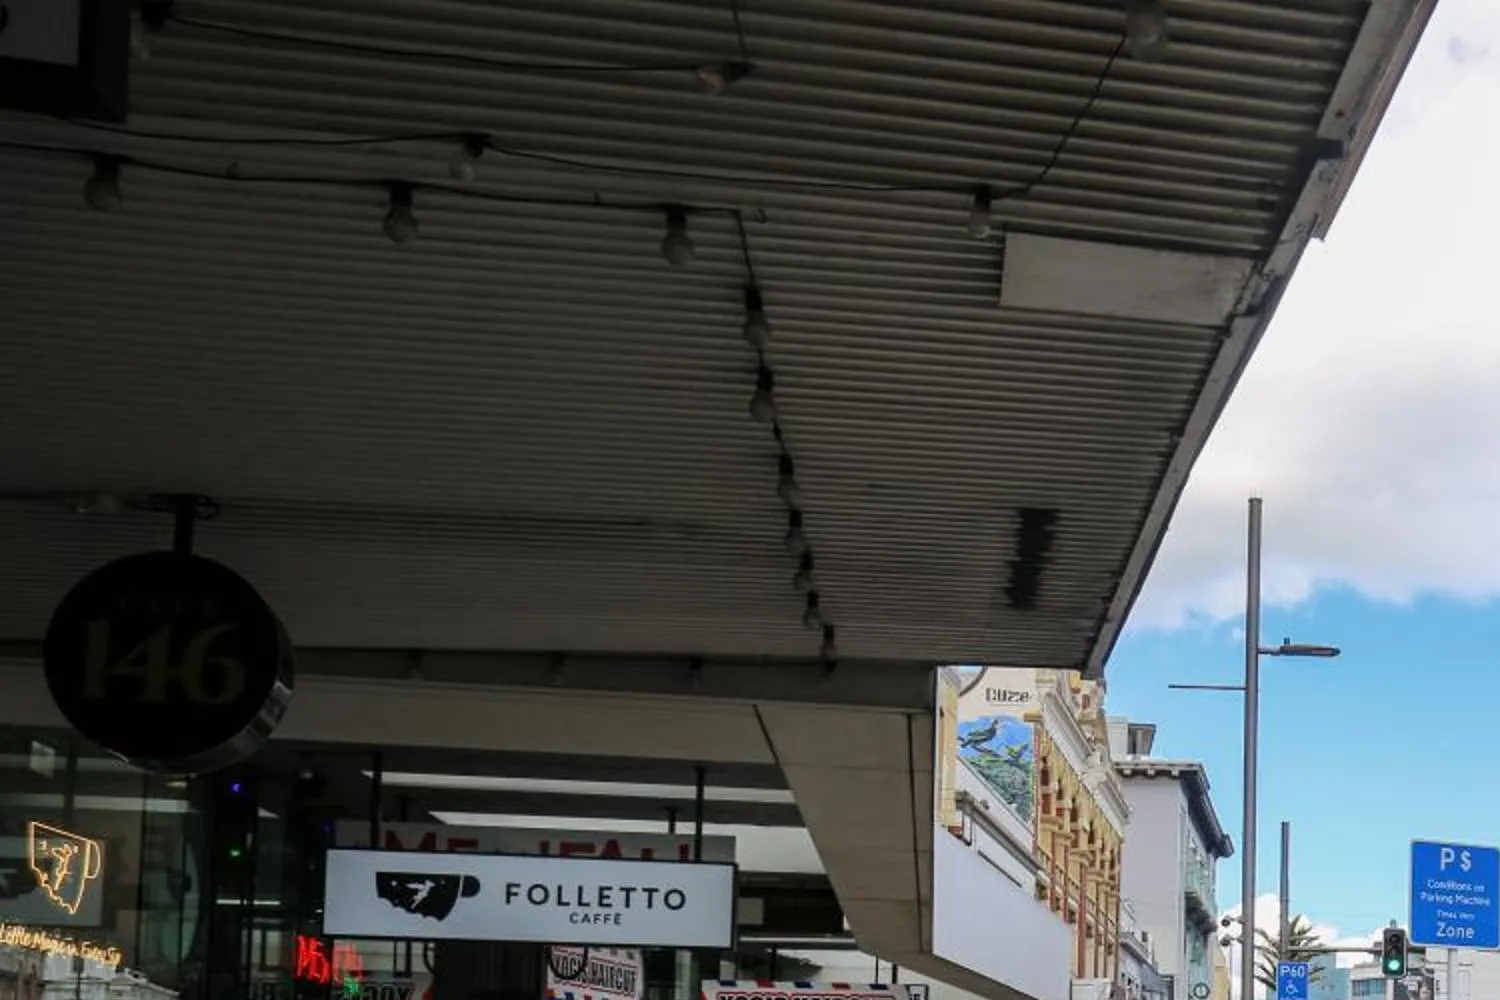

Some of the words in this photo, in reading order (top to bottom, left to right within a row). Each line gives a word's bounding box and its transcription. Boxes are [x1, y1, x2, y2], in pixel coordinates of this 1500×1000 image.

[77, 617, 247, 707] 146
[1440, 847, 1455, 871] P
[1427, 879, 1473, 891] Conditions
[505, 882, 687, 911] FOLLETTO
[1420, 891, 1453, 905] Parking
[1455, 893, 1491, 906] Machine
[1436, 921, 1475, 939] Zone
[1280, 965, 1305, 977] P60
